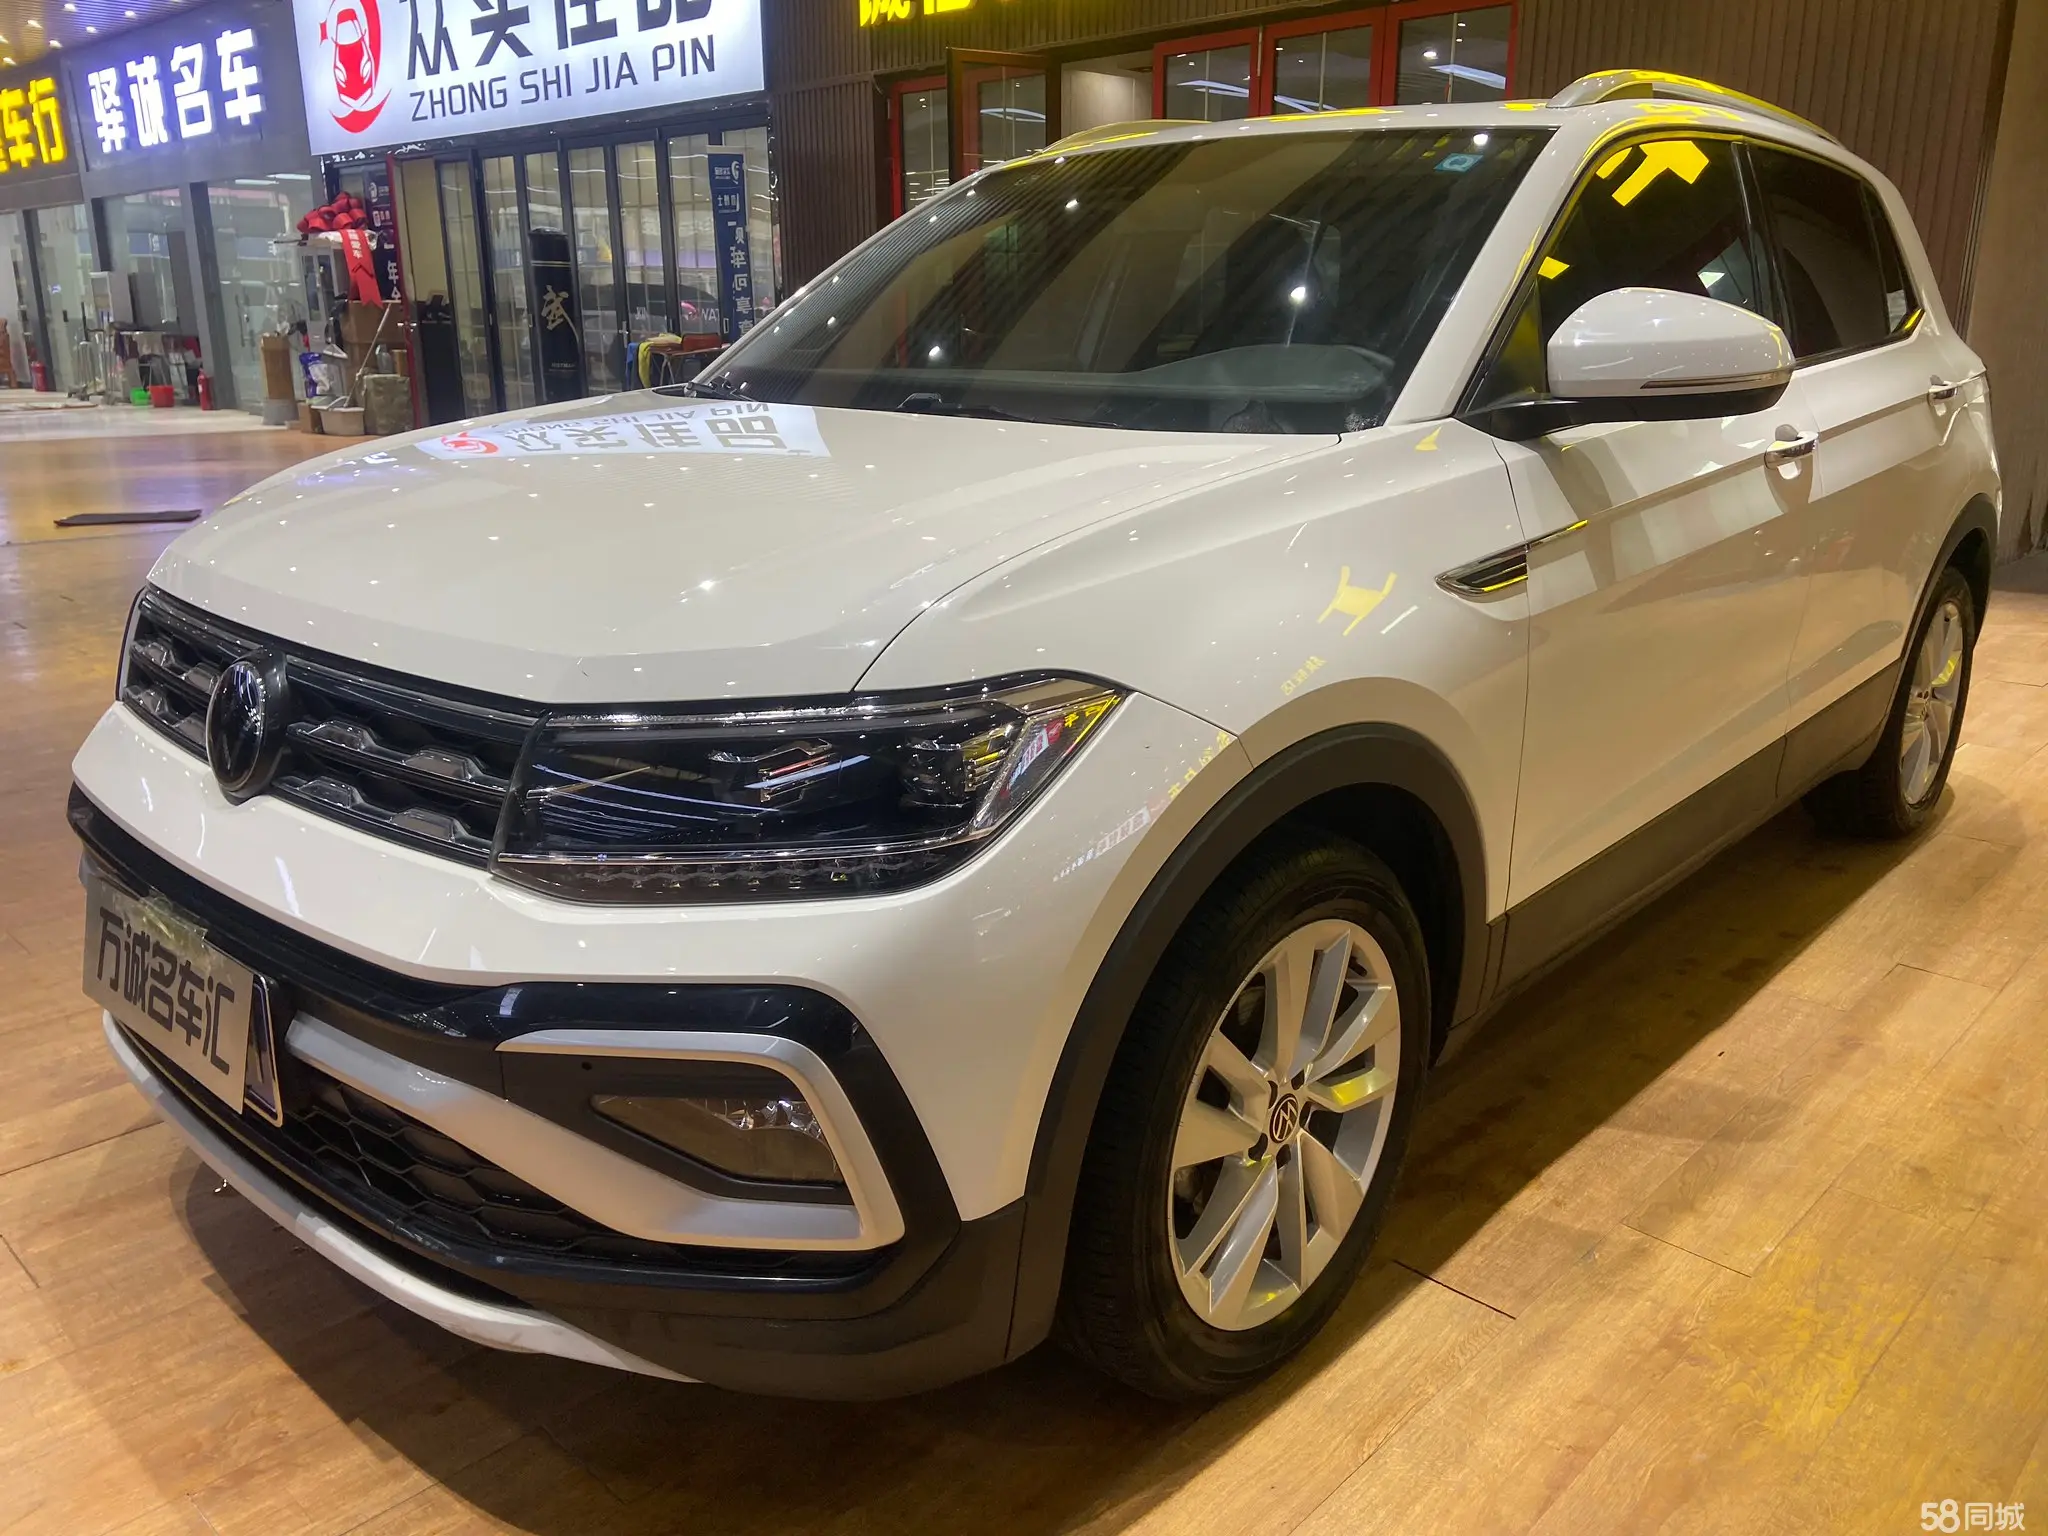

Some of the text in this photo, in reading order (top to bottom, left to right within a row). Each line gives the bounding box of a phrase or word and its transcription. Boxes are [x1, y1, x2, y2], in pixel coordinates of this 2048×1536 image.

[399, 0, 714, 80] 众实
[408, 34, 717, 122] ZHONG SHI JIA PIN
[0, 77, 66, 173] 车行
[97, 906, 236, 1076] 万诚名车汇
